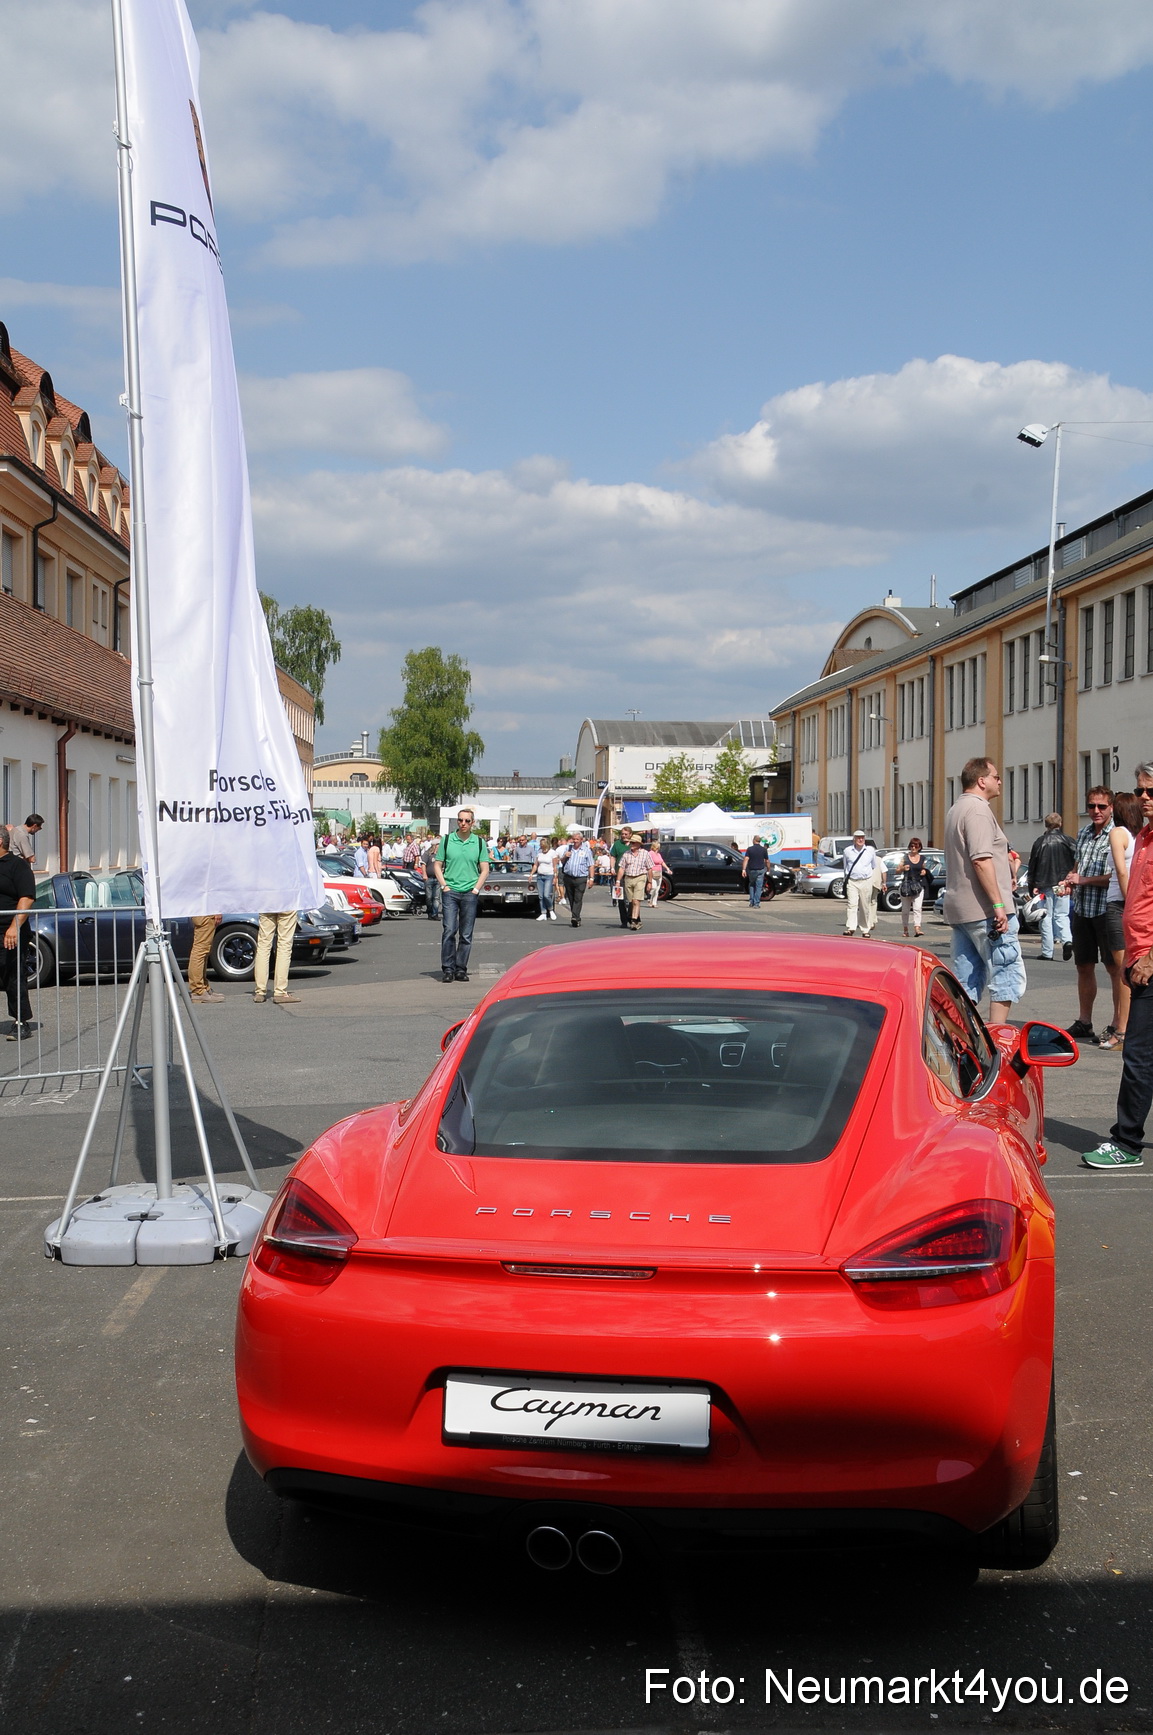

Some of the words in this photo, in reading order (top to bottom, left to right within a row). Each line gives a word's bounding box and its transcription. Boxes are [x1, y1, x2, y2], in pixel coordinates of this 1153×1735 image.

[1112, 746, 1119, 772] 5
[475, 1206, 731, 1224] PORSCHE
[490, 1387, 661, 1431] Cayman
